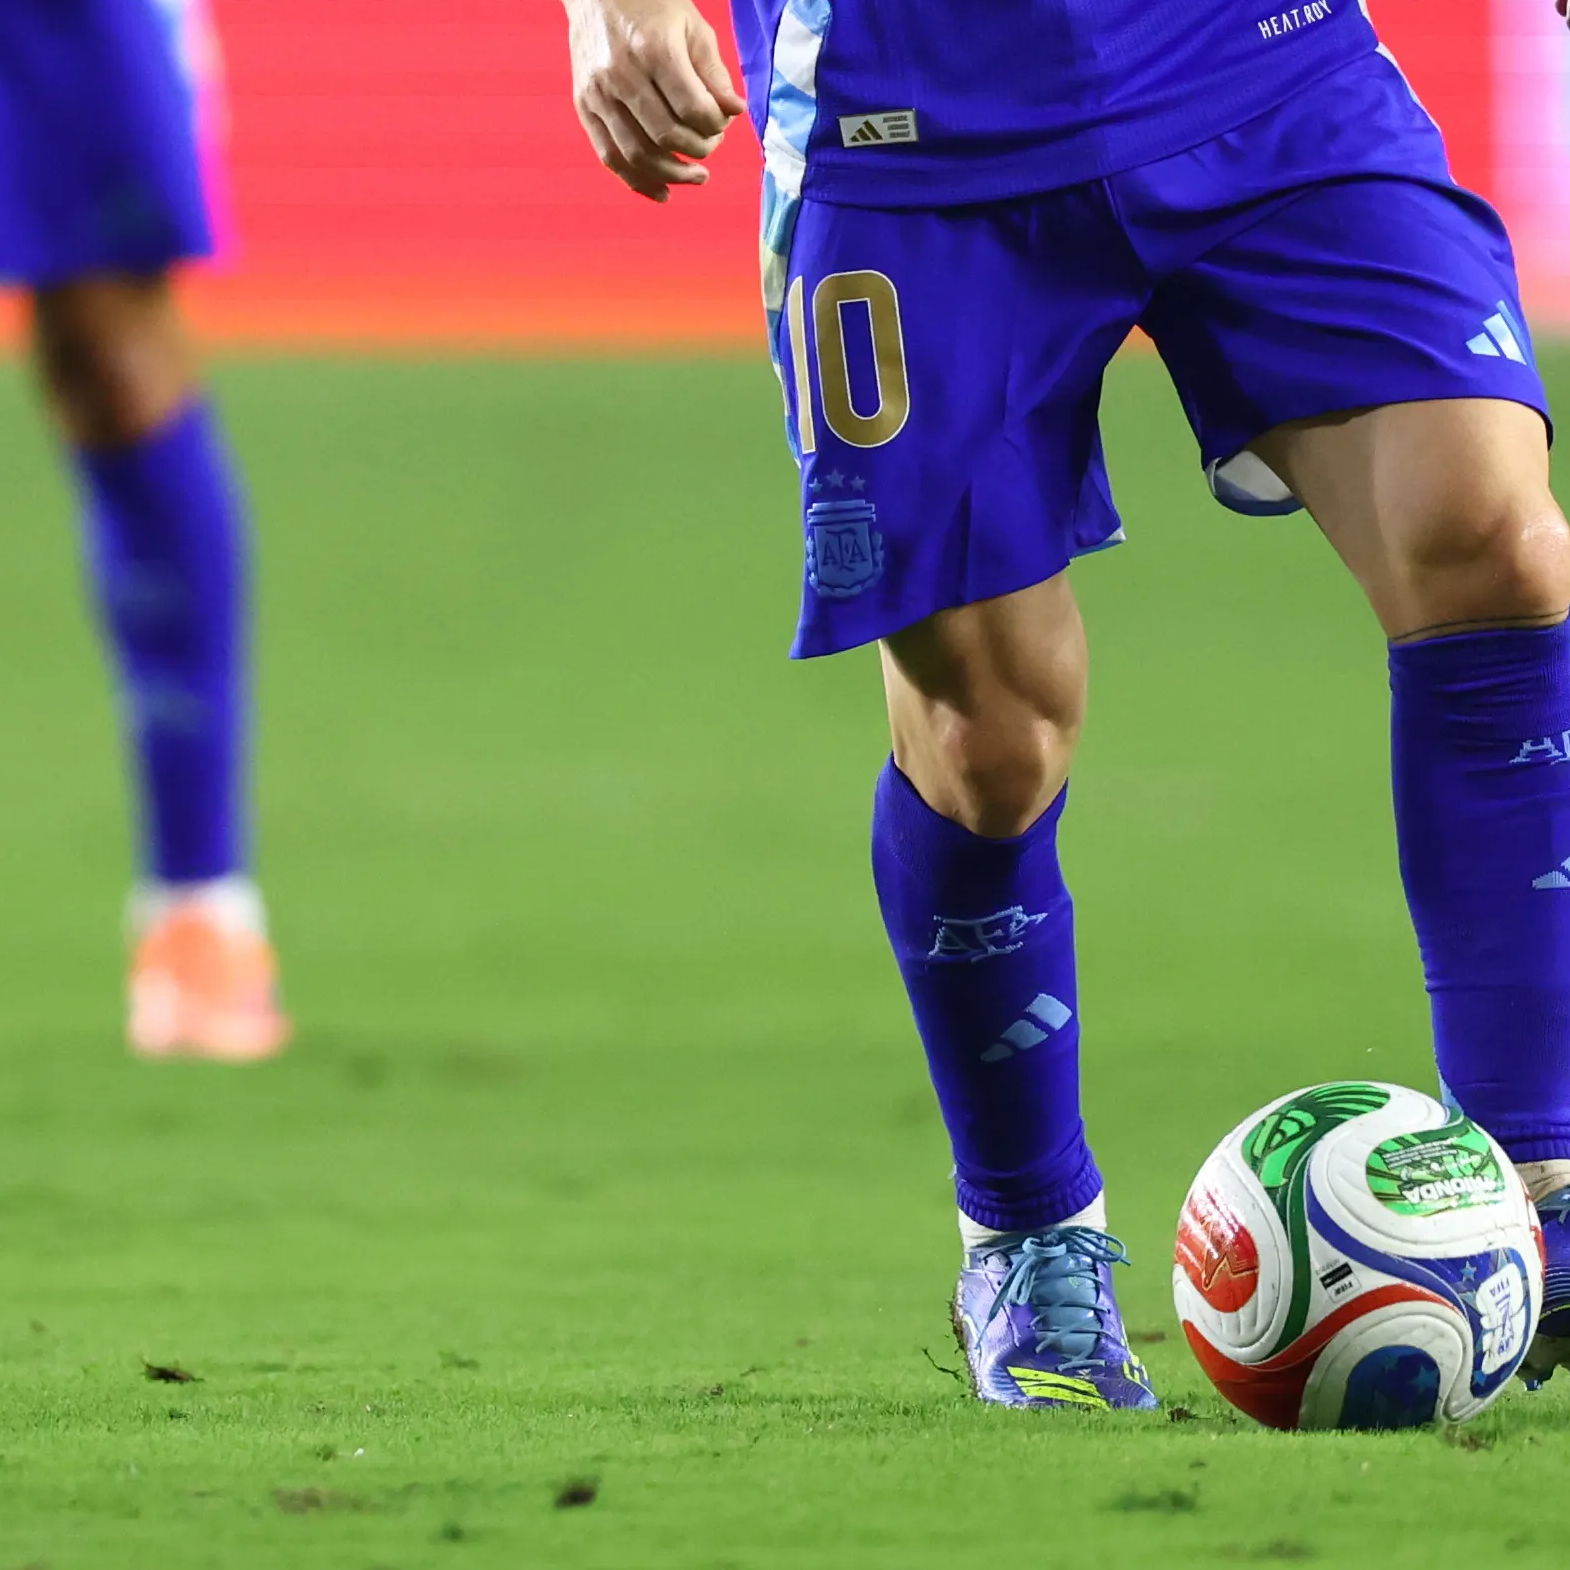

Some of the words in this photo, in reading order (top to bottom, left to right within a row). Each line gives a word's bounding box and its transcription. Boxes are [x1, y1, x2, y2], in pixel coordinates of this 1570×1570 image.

[786, 269, 911, 455] 10
[822, 527, 869, 572] AFA
[1490, 1277, 1510, 1297] FIFA
